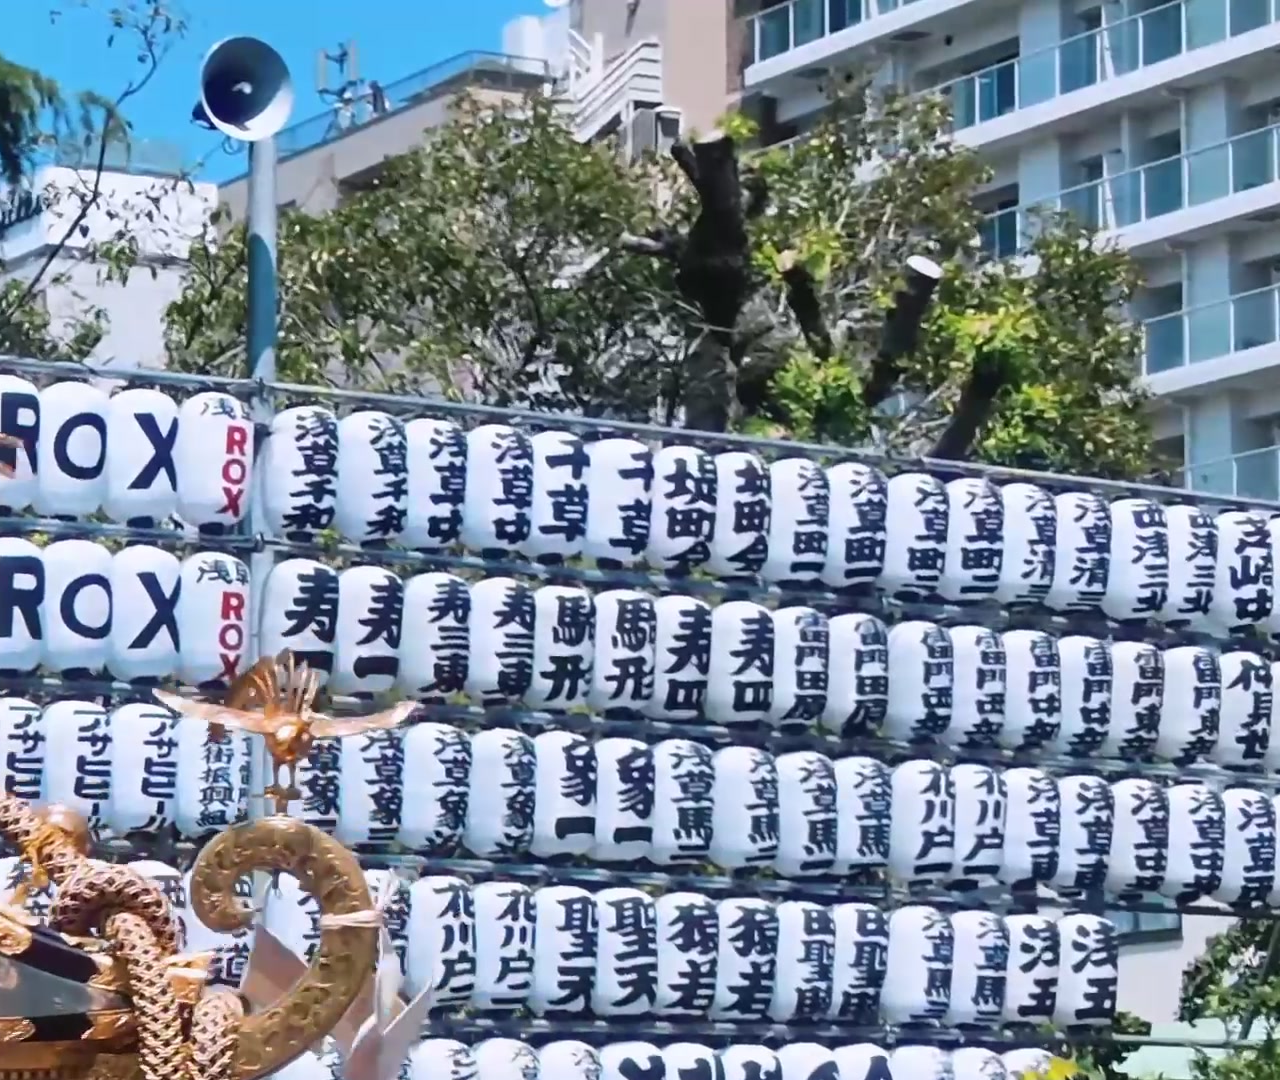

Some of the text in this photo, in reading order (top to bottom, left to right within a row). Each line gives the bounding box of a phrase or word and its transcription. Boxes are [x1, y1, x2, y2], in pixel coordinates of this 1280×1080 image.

[0, 392, 178, 492] ROX
[215, 425, 249, 518] ROX
[218, 592, 246, 680] ROX
[5, 704, 46, 800] アサヒビ
